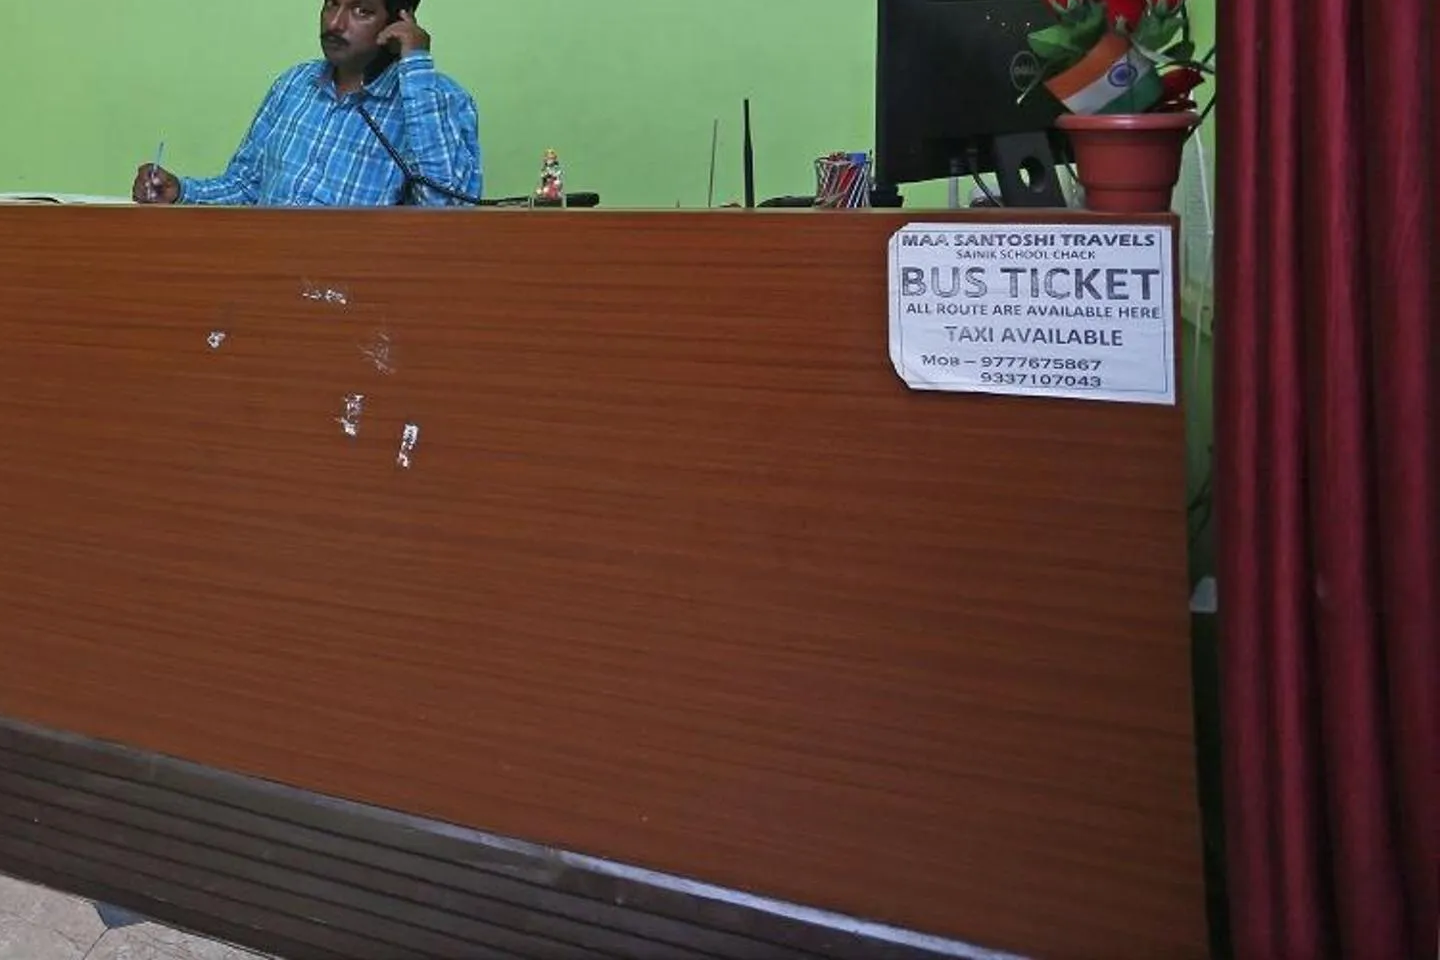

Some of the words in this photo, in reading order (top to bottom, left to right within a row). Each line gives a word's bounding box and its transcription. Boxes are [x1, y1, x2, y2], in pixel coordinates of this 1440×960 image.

[902, 234, 950, 247] MAA
[953, 234, 1056, 246] SANTOSHI
[1060, 233, 1156, 247] TRAVELS
[956, 250, 998, 259] SAINIK
[1000, 250, 1049, 259] SCHOOL
[1053, 250, 1096, 260] CHACK
[901, 266, 988, 298] BUS
[1000, 267, 1160, 300] TICKET
[906, 303, 932, 314] ALL
[936, 303, 988, 316] ROUTE
[992, 305, 1022, 316] ARE
[1026, 306, 1112, 318] AVAILABLE
[1118, 306, 1161, 320] HERE
[944, 326, 994, 342] TAXI
[1000, 328, 1124, 346] AVAILABLE
[980, 356, 1102, 371] 9777675867
[980, 372, 1102, 387] 9337107043
